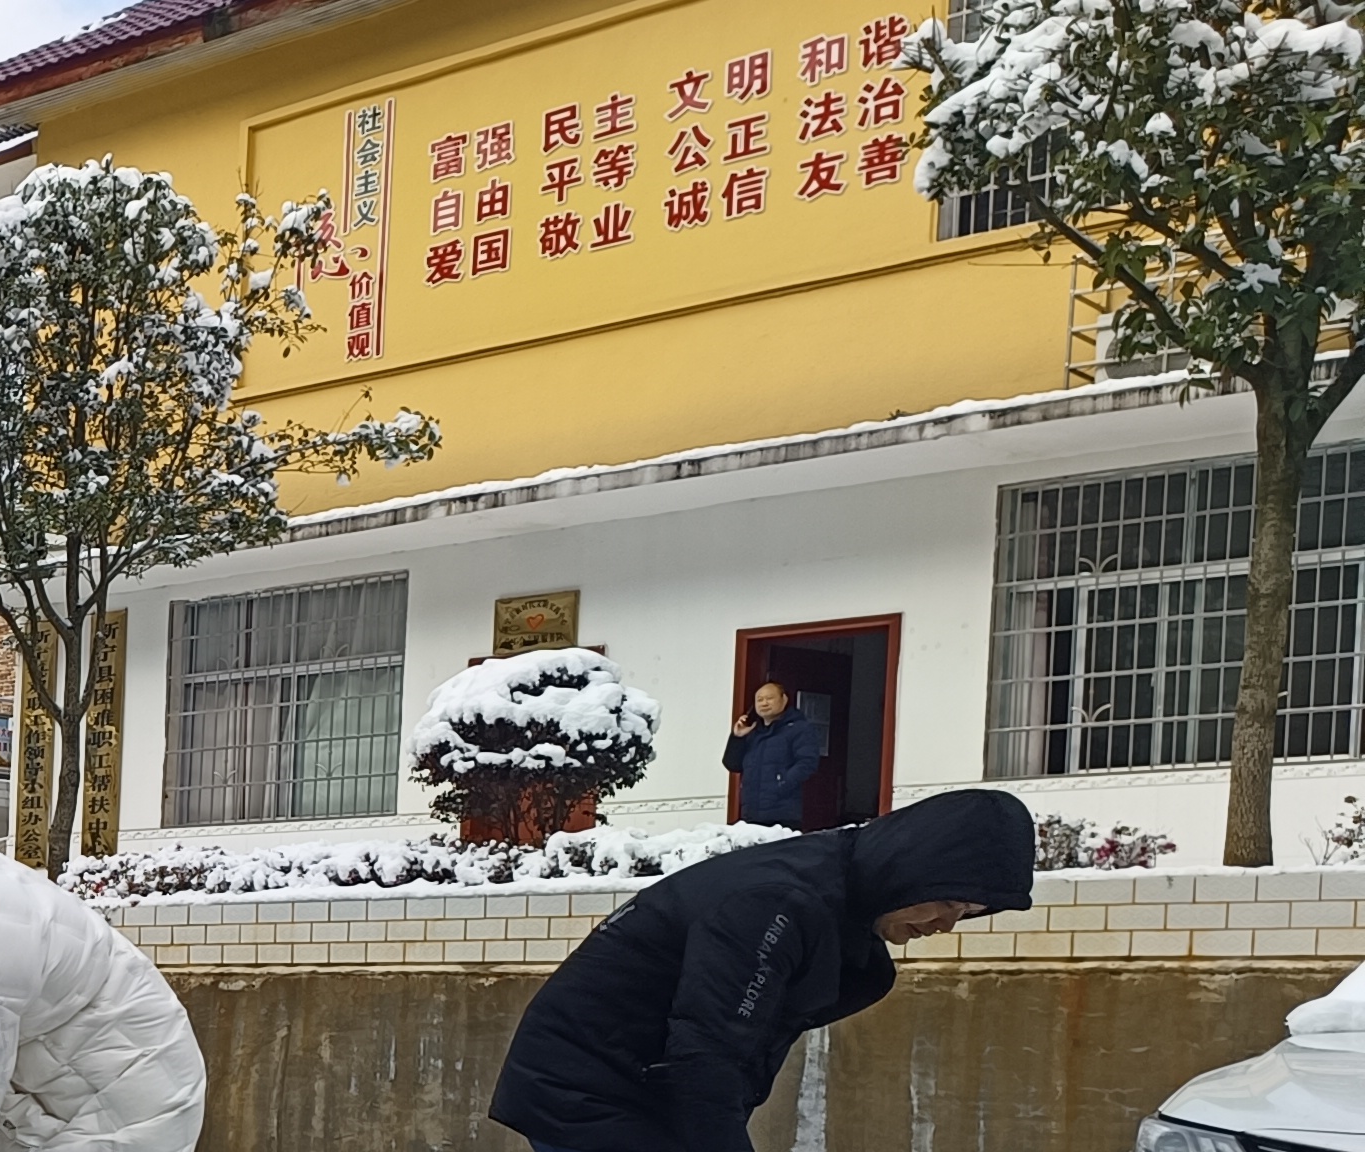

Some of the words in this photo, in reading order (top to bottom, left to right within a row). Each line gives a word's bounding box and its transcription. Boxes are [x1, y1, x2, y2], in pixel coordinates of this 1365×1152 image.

[353, 105, 382, 228] 社会主义
[430, 122, 513, 181] 富强
[543, 94, 635, 153] 民主
[667, 51, 769, 119] 文明
[799, 15, 909, 84] 和谐
[431, 178, 510, 233] 自由
[541, 144, 636, 203] 平等
[667, 114, 768, 173] 公正
[798, 77, 906, 141] 法治
[425, 228, 510, 285] 爱国
[538, 203, 632, 258] 敬业
[663, 168, 767, 228] 诚信
[797, 134, 907, 199] 友善
[346, 271, 374, 359] 价值观
